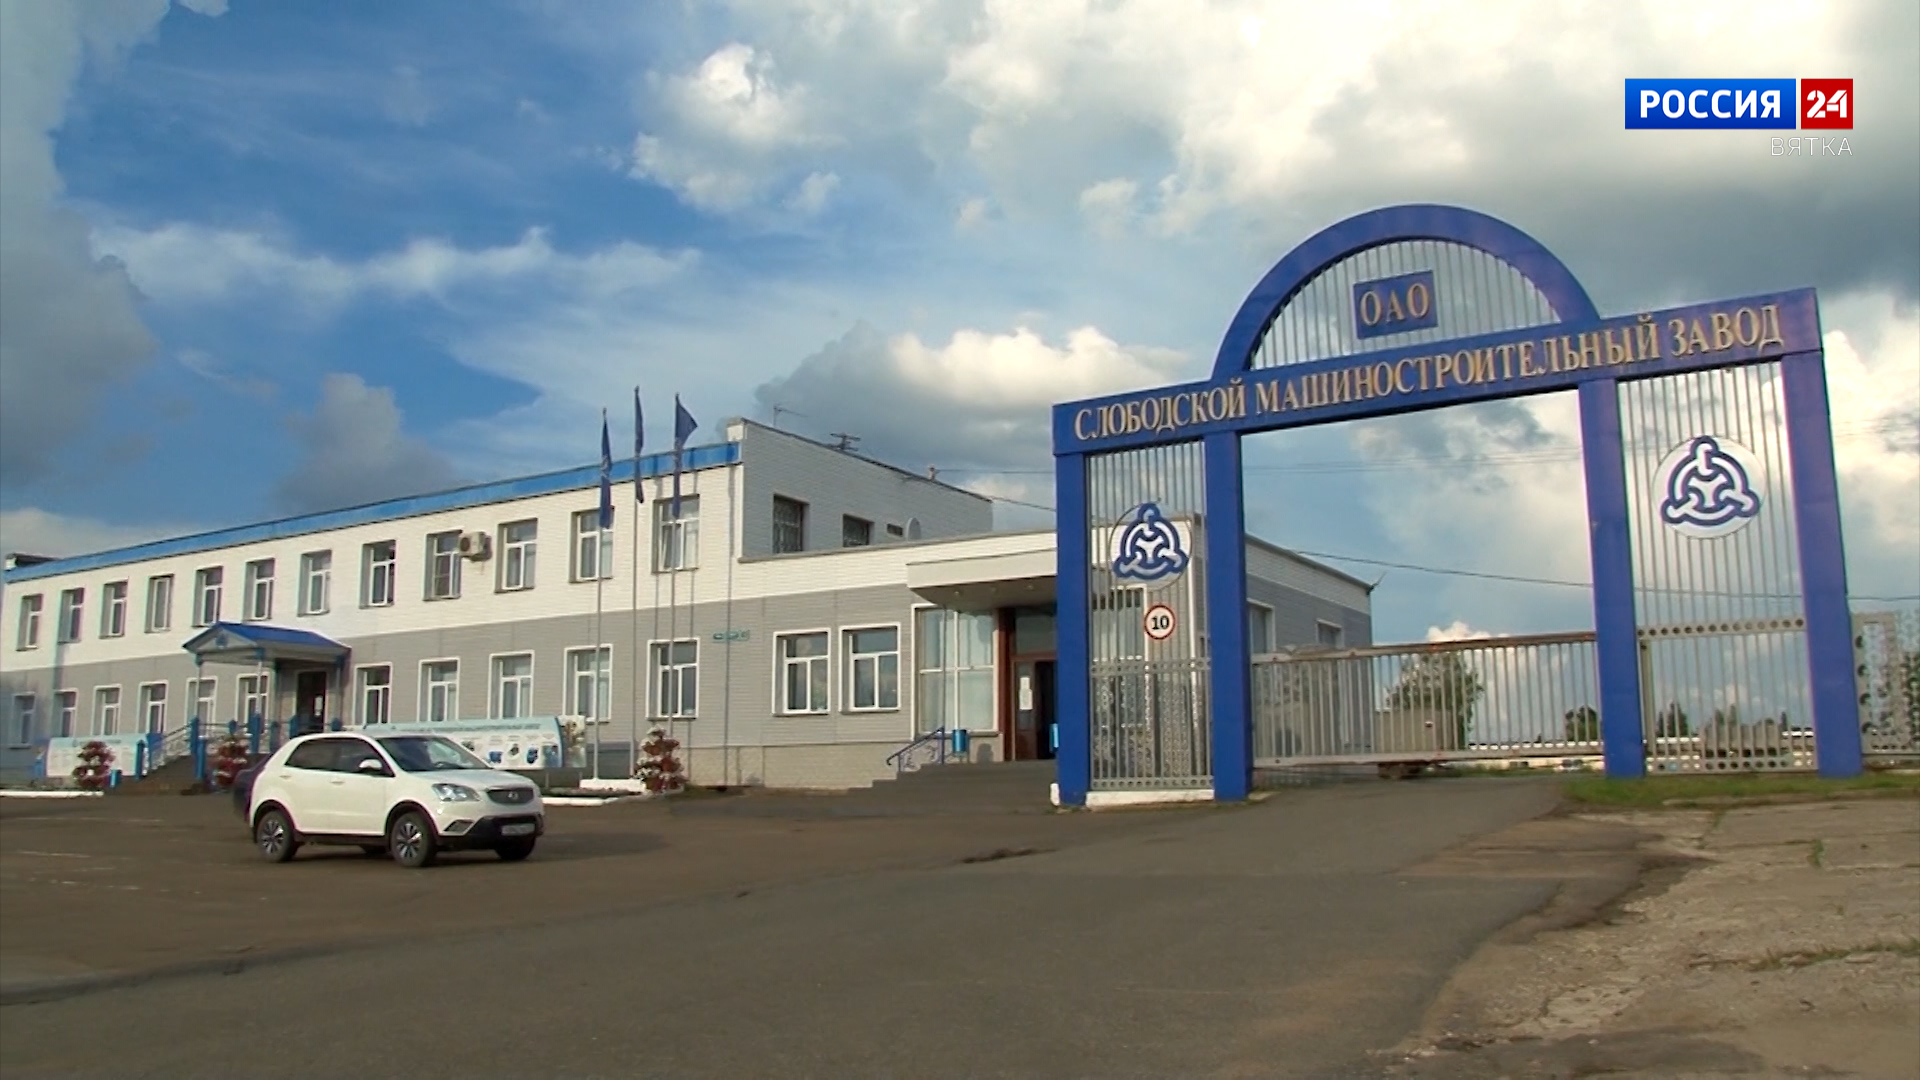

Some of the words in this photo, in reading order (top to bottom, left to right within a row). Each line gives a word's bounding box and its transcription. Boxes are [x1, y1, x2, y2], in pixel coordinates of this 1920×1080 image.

[1359, 282, 1430, 327] ОАО
[1074, 377, 1247, 442] СЛОБОДСКОЙ
[1256, 313, 1662, 415] МАШИНОСТРОИТЕЛЬНЫЙ
[1668, 304, 1785, 358] ЗАВОД
[1151, 615, 1170, 630] 10
